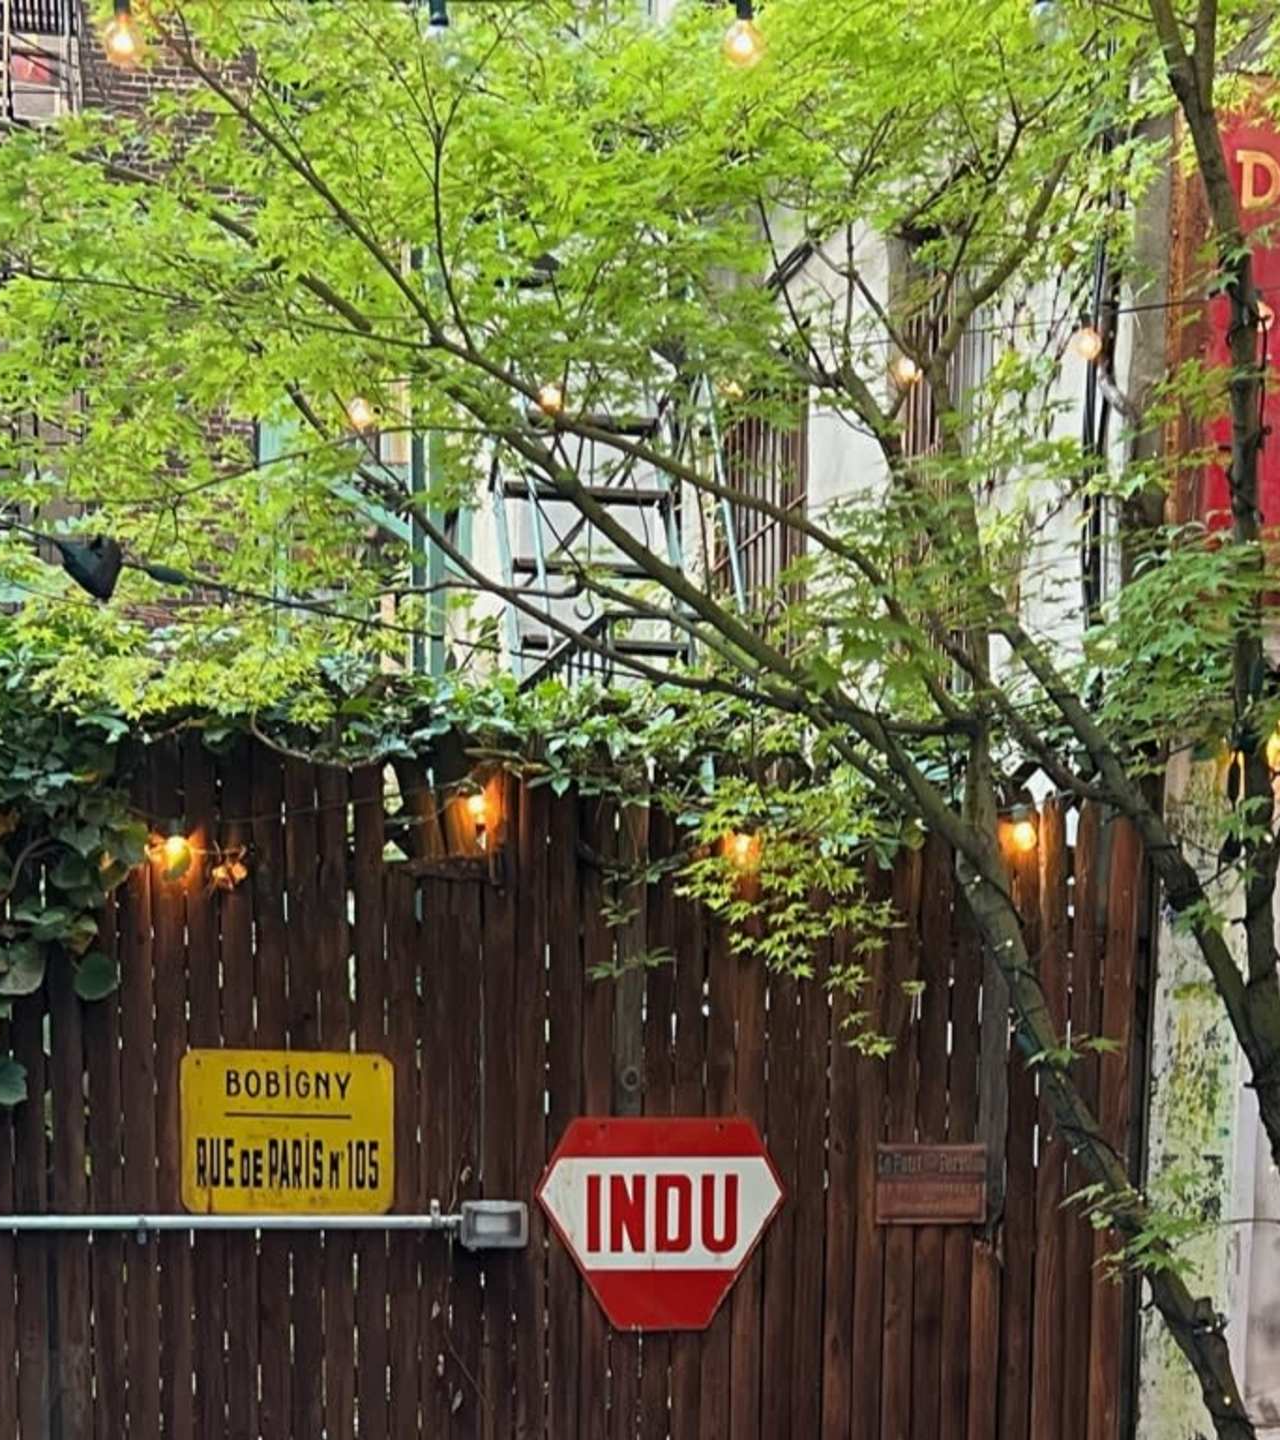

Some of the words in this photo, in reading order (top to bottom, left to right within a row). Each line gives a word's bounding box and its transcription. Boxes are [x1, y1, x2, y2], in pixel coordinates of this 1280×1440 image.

[196, 1137, 234, 1188] RUE
[347, 1139, 379, 1190] 105
[586, 1174, 739, 1254] INDU
